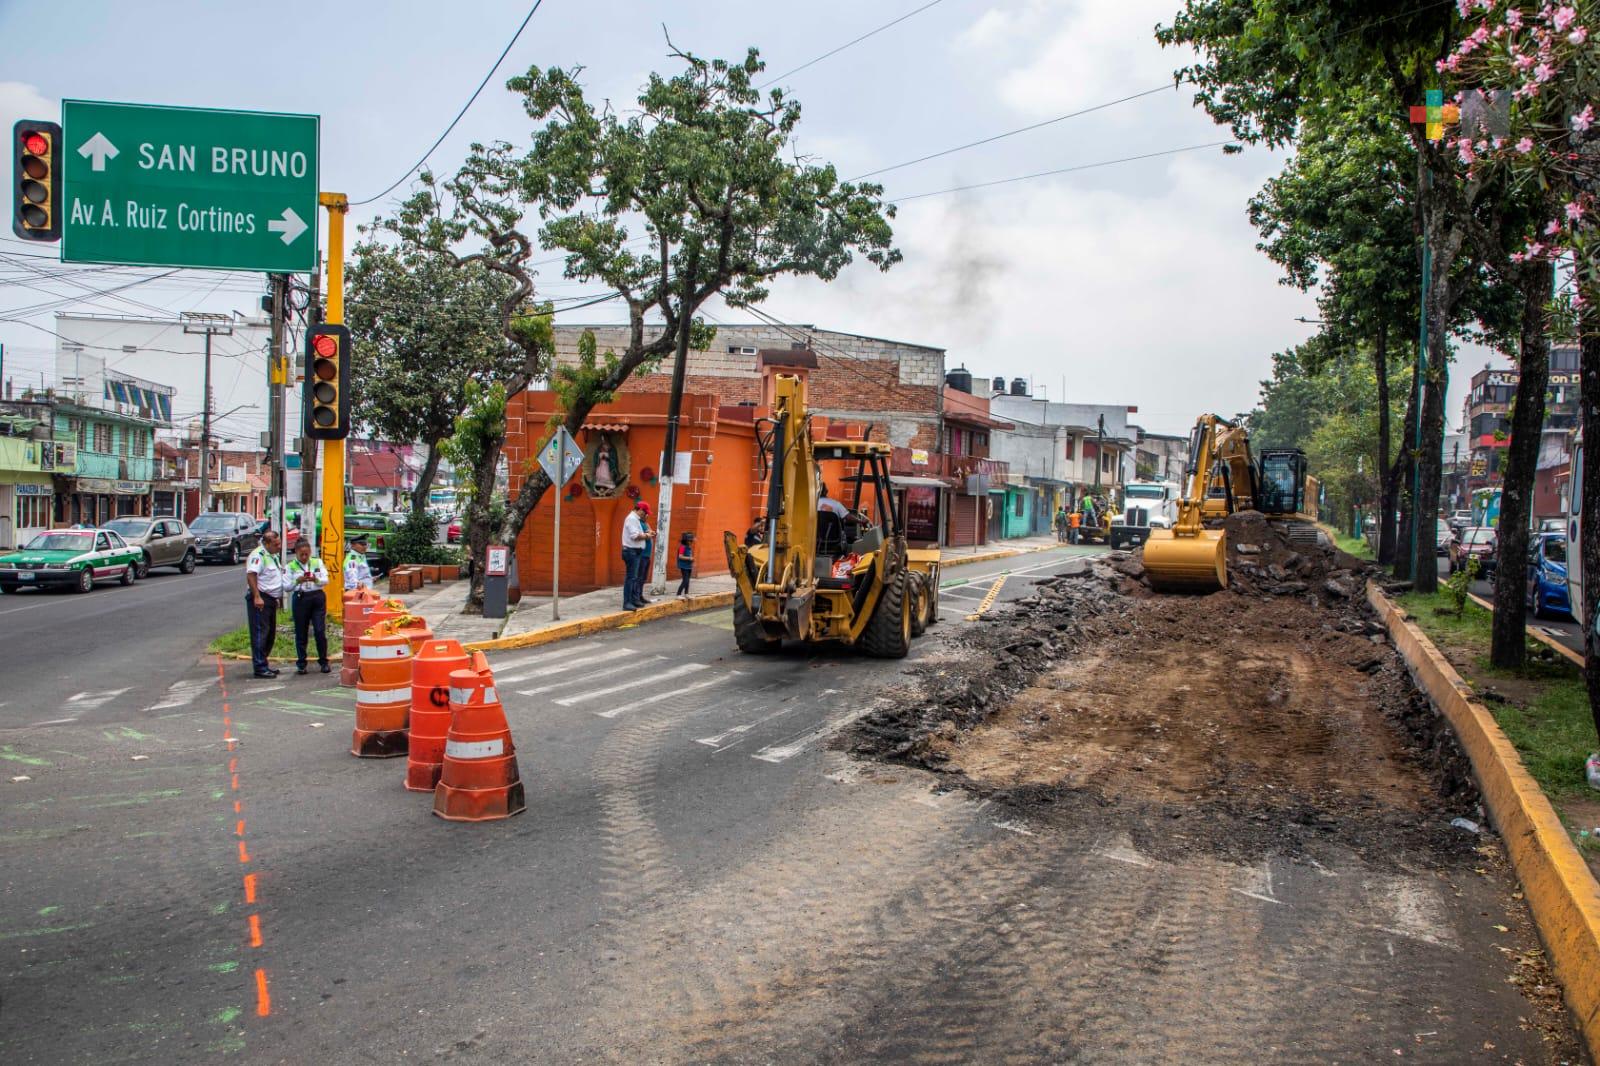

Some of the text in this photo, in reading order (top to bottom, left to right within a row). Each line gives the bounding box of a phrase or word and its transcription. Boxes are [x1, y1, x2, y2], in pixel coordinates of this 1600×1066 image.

[138, 143, 307, 178] SAN BRUNO
[71, 197, 256, 235] Av. A. Ruiz Cortines
